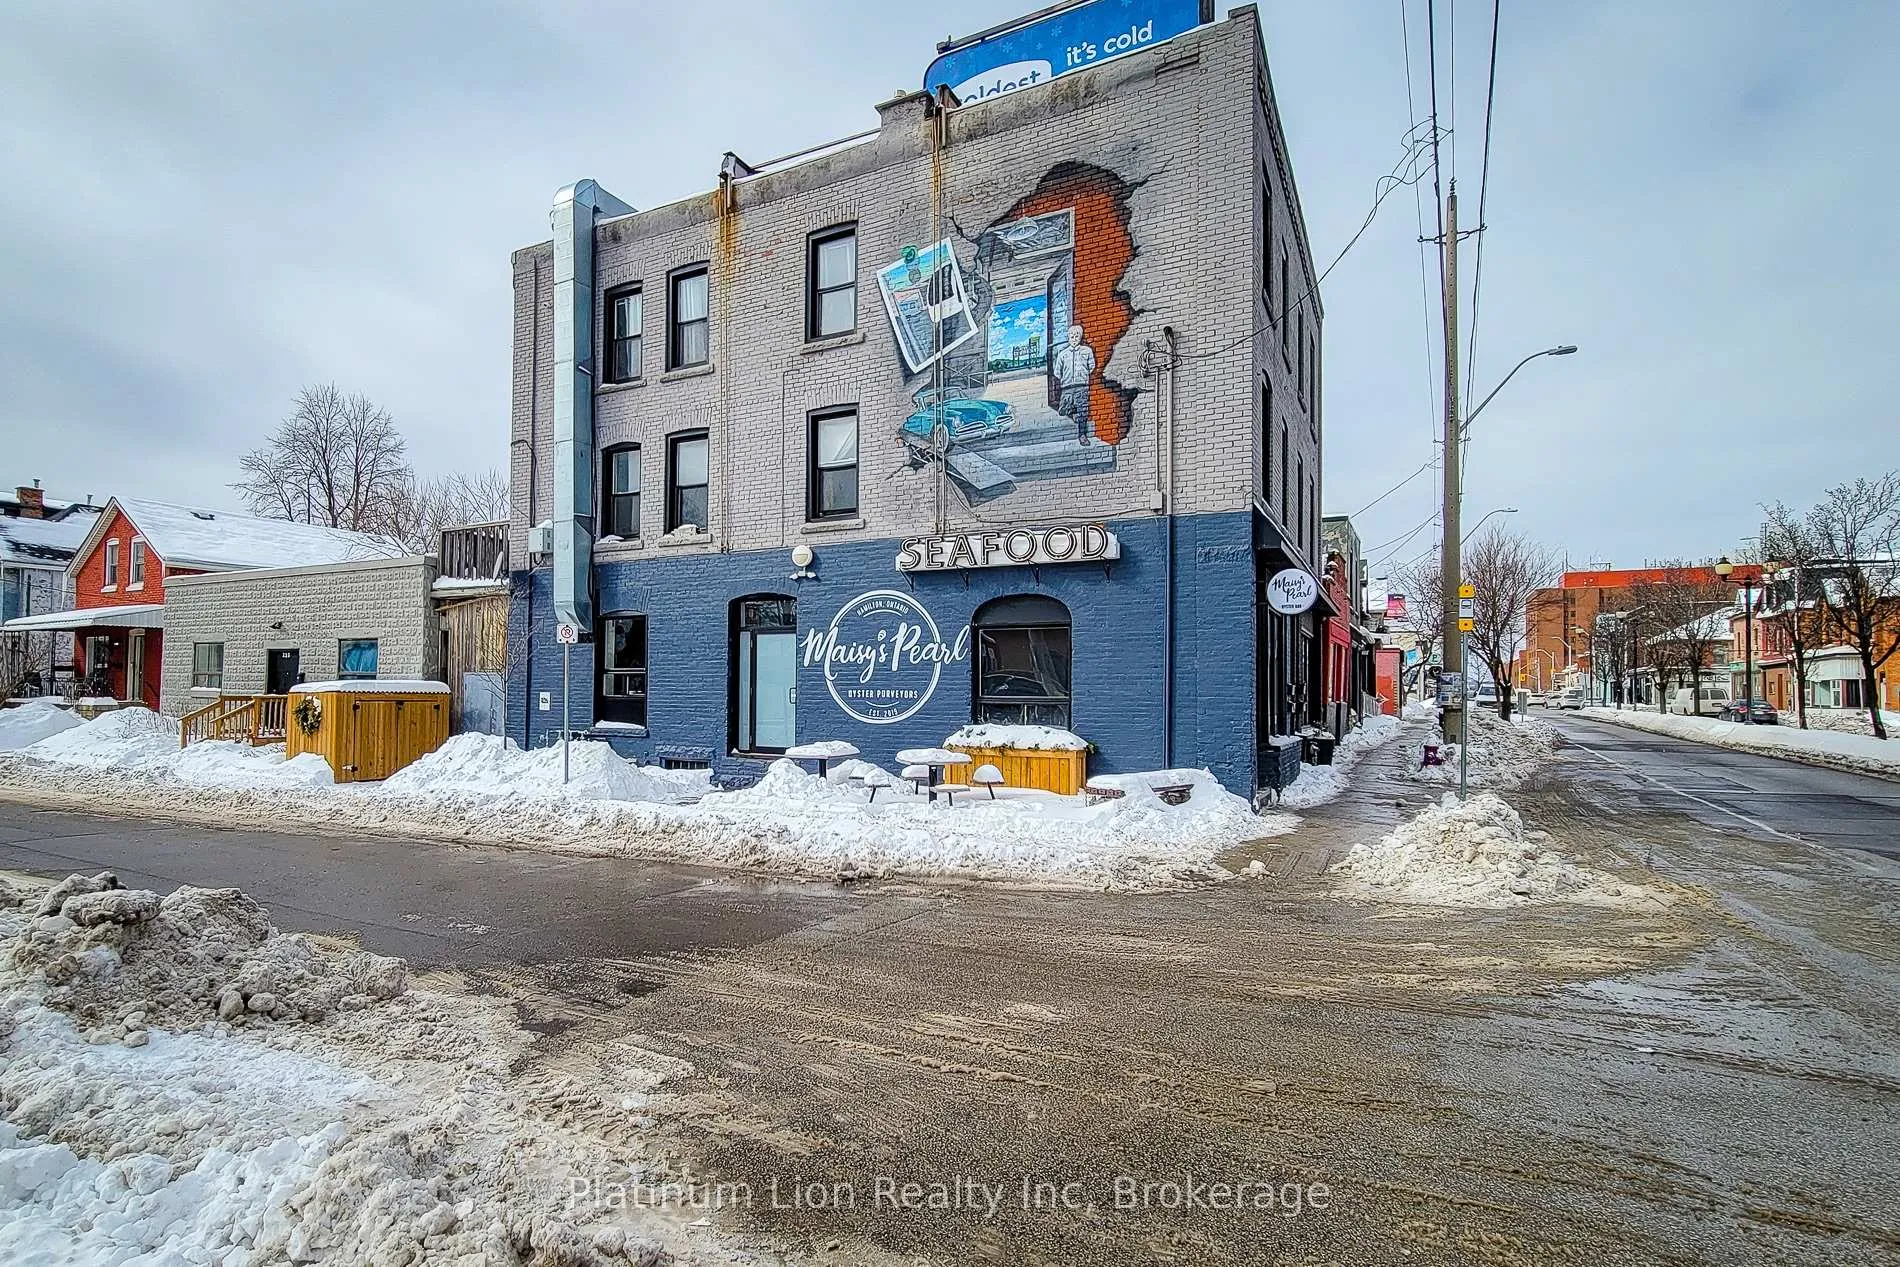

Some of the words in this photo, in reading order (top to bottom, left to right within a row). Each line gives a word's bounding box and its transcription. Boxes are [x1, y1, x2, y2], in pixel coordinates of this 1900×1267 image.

[1066, 42, 1097, 67] it's
[1103, 19, 1153, 54] cold
[900, 524, 1108, 569] SEAFOOD
[1286, 585, 1312, 602] Pearl
[799, 626, 889, 684] Maisy's
[890, 622, 971, 672] Pearl
[848, 689, 874, 698] OYSTER
[876, 689, 918, 699] PURVEYORS
